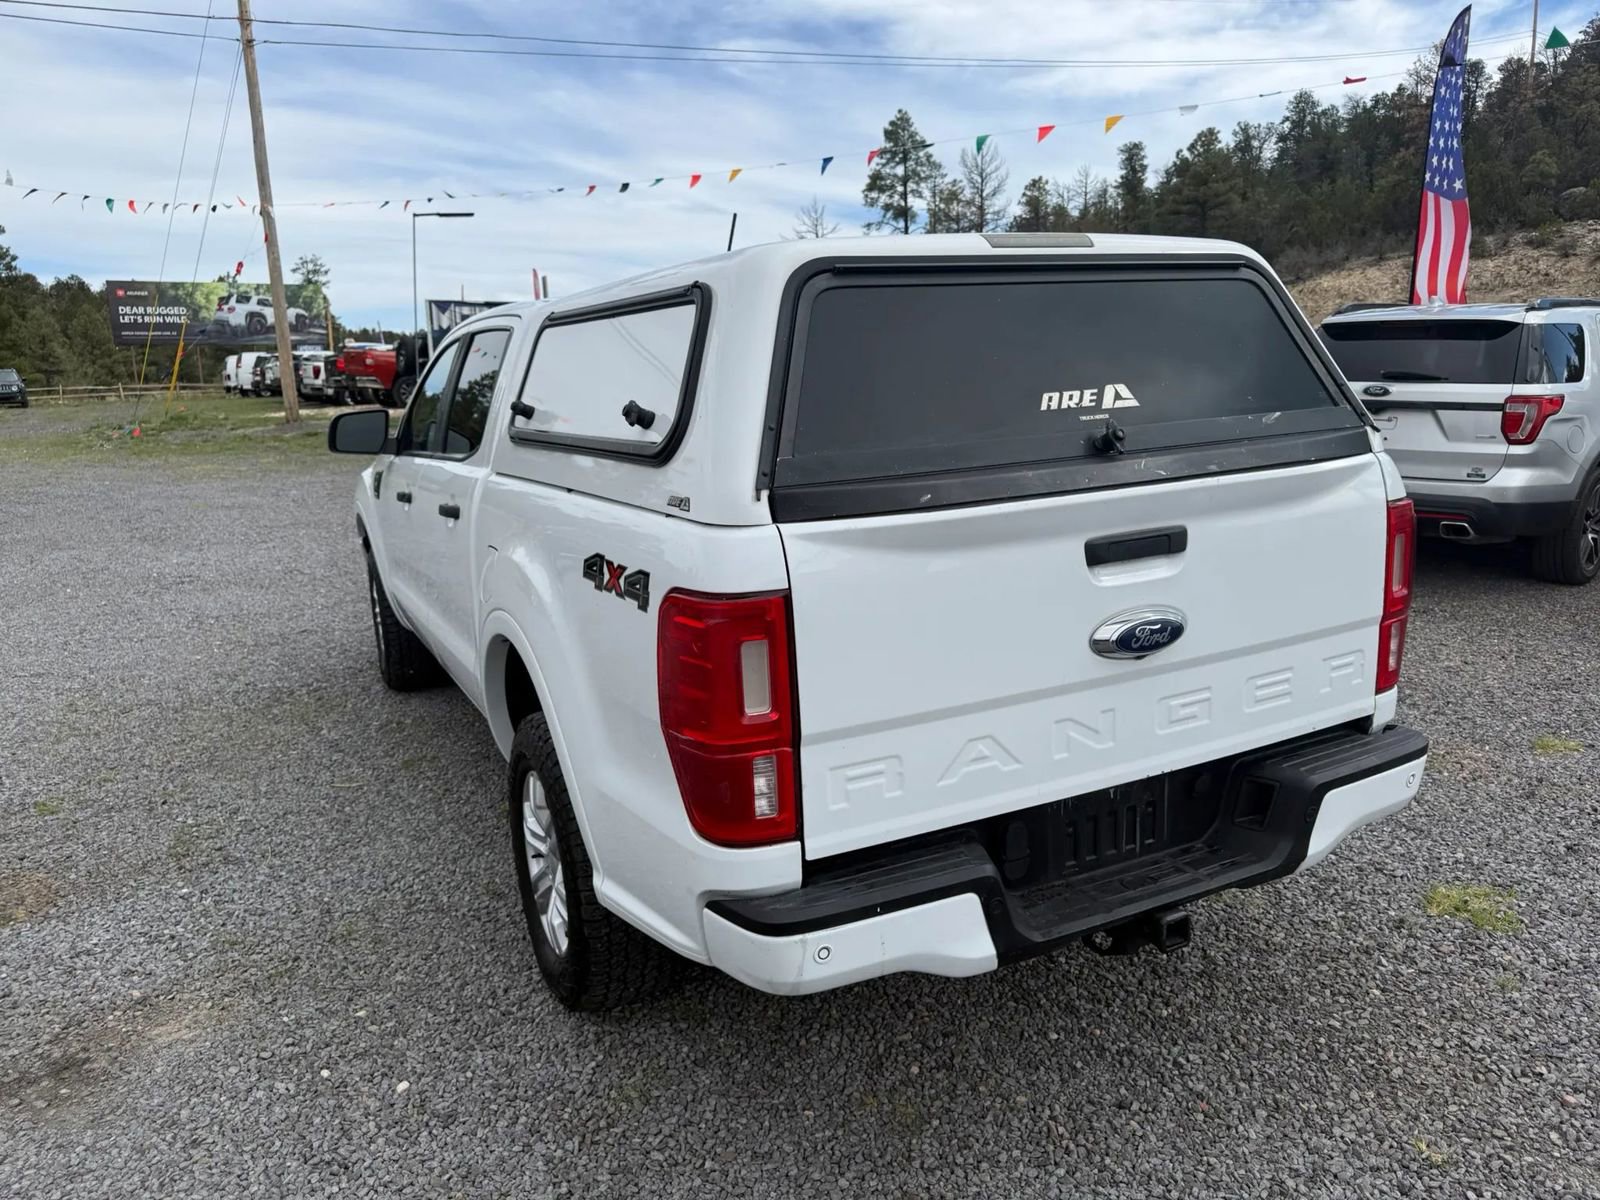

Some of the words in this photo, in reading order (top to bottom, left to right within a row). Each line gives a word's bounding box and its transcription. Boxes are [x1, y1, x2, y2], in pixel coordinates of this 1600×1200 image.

[118, 305, 146, 315] DEAR
[119, 315, 143, 324] LET'S
[144, 315, 163, 324] RUN
[1040, 389, 1098, 411] ARE
[1131, 624, 1172, 649] Ford
[828, 648, 1367, 811] RANGER
